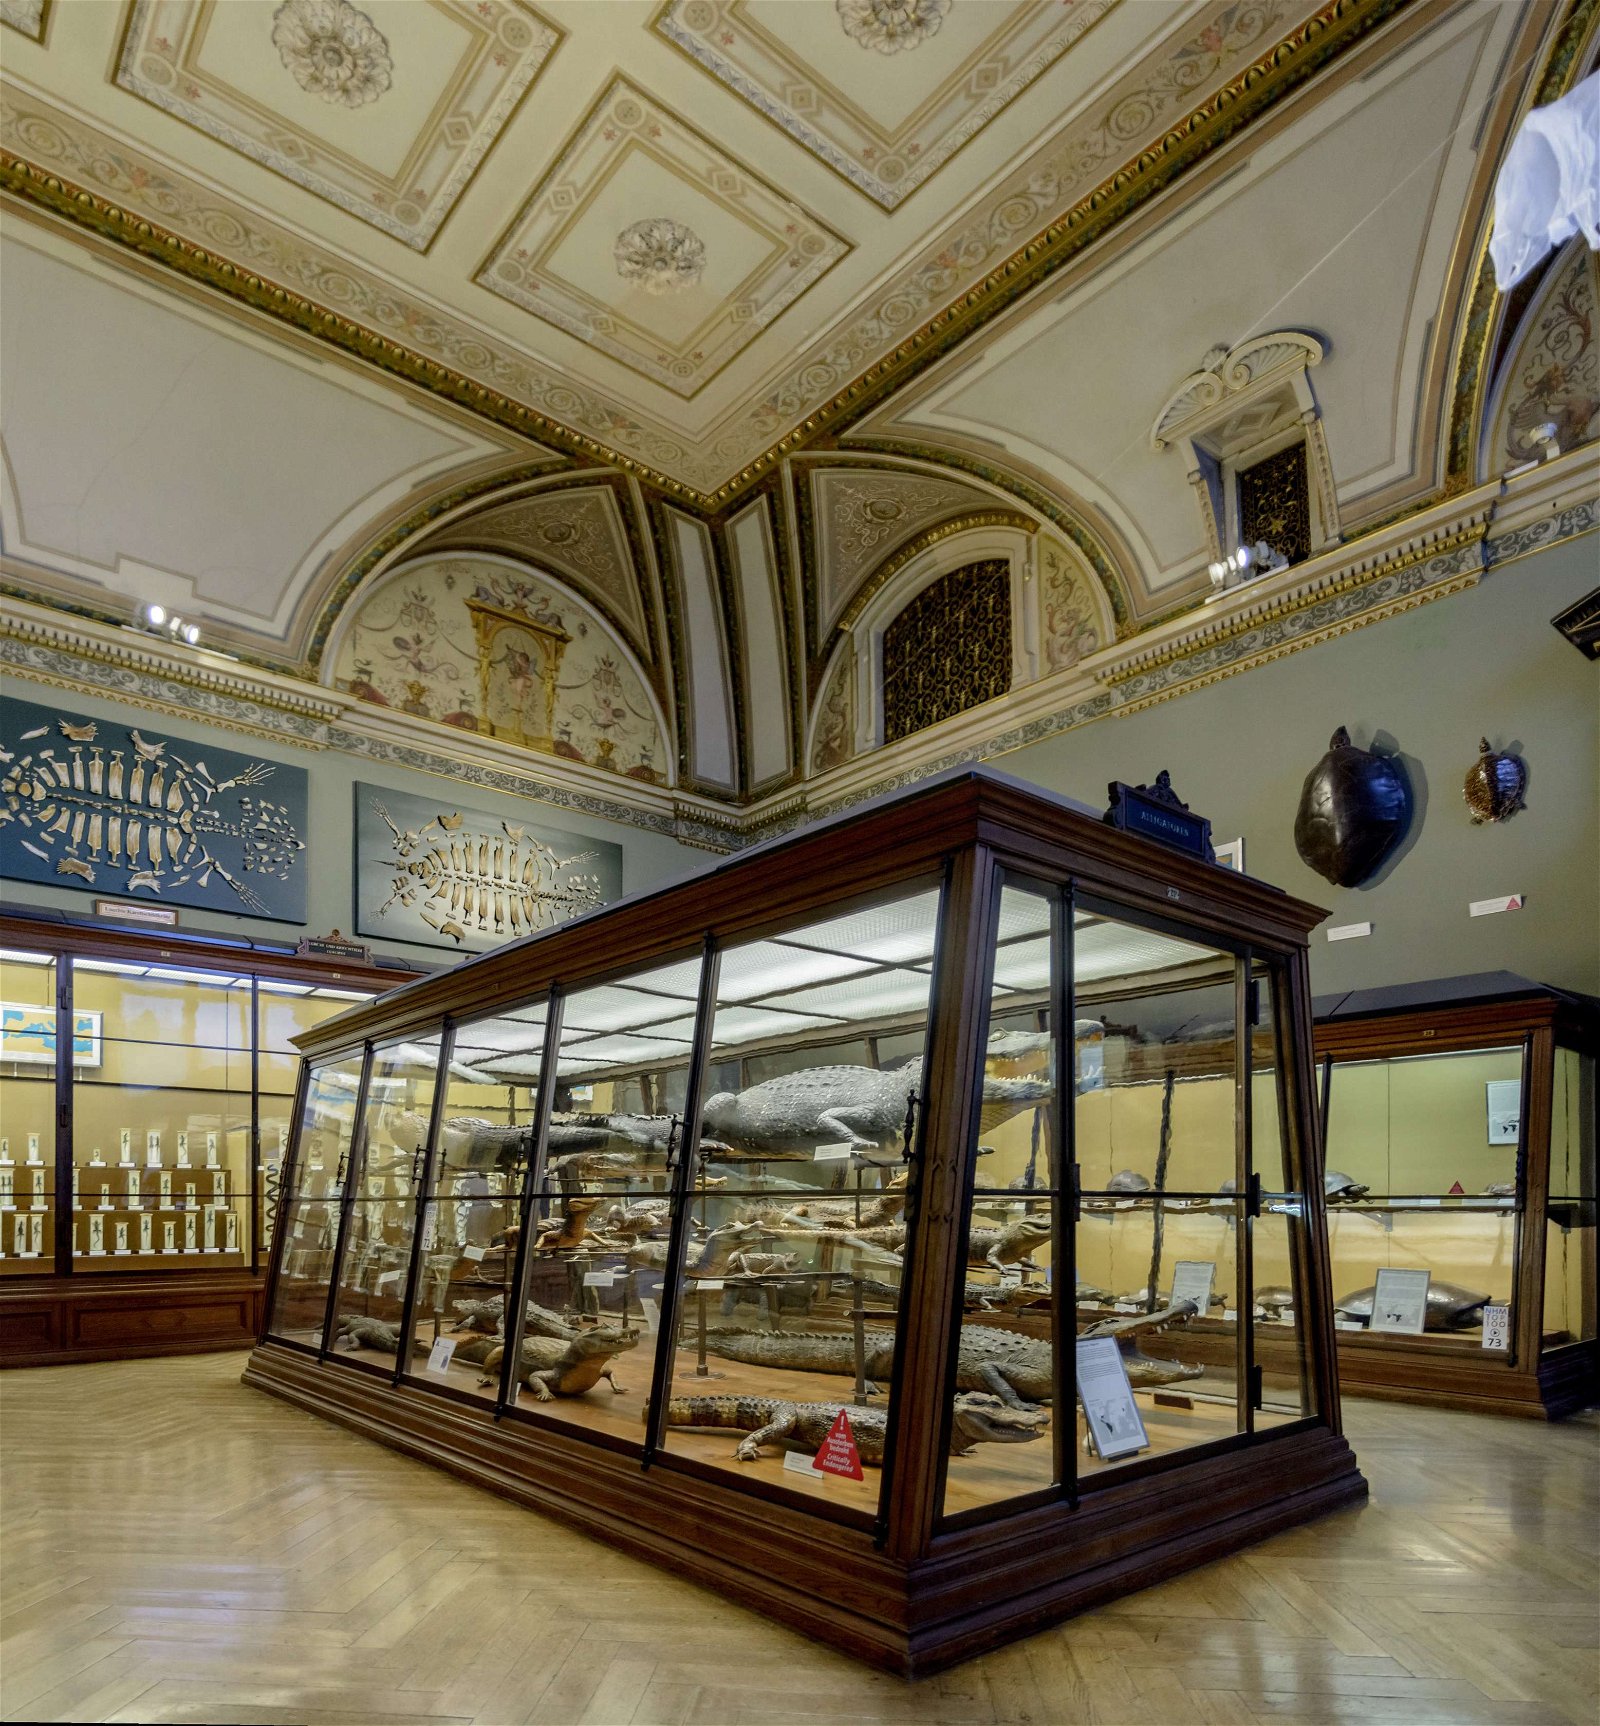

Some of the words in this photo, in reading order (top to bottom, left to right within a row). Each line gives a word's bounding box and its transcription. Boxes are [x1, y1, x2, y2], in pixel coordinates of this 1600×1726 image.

[1487, 1338, 1502, 1347] 73
[827, 1453, 851, 1466] Critically
[823, 1460, 854, 1473] Endangered
